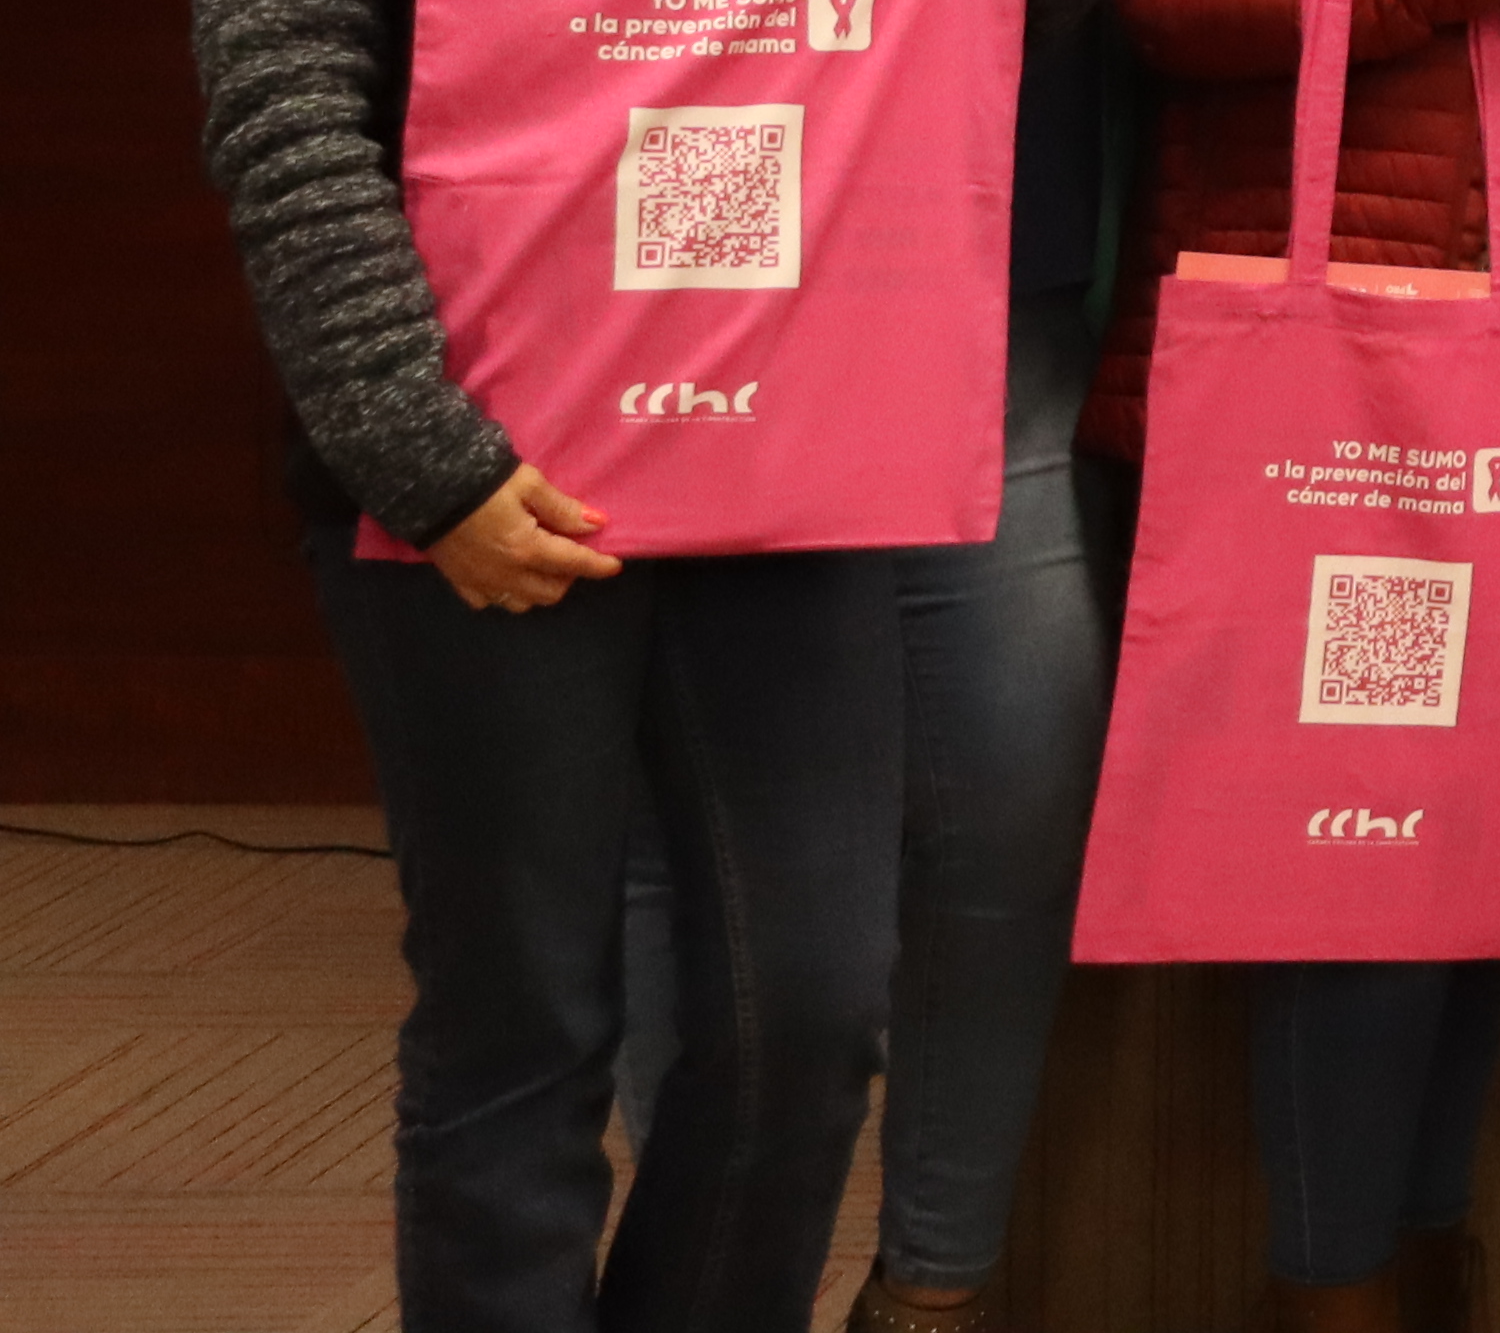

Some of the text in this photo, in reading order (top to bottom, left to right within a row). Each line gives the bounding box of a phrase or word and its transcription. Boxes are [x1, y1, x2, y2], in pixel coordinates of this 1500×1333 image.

[570, 7, 796, 38] a la prevención del
[598, 37, 796, 61] cáncer de mama
[1333, 440, 1467, 469] YO ME SUMO
[1265, 459, 1466, 491] a la prevención del
[1287, 486, 1464, 514] cáncer de mama
